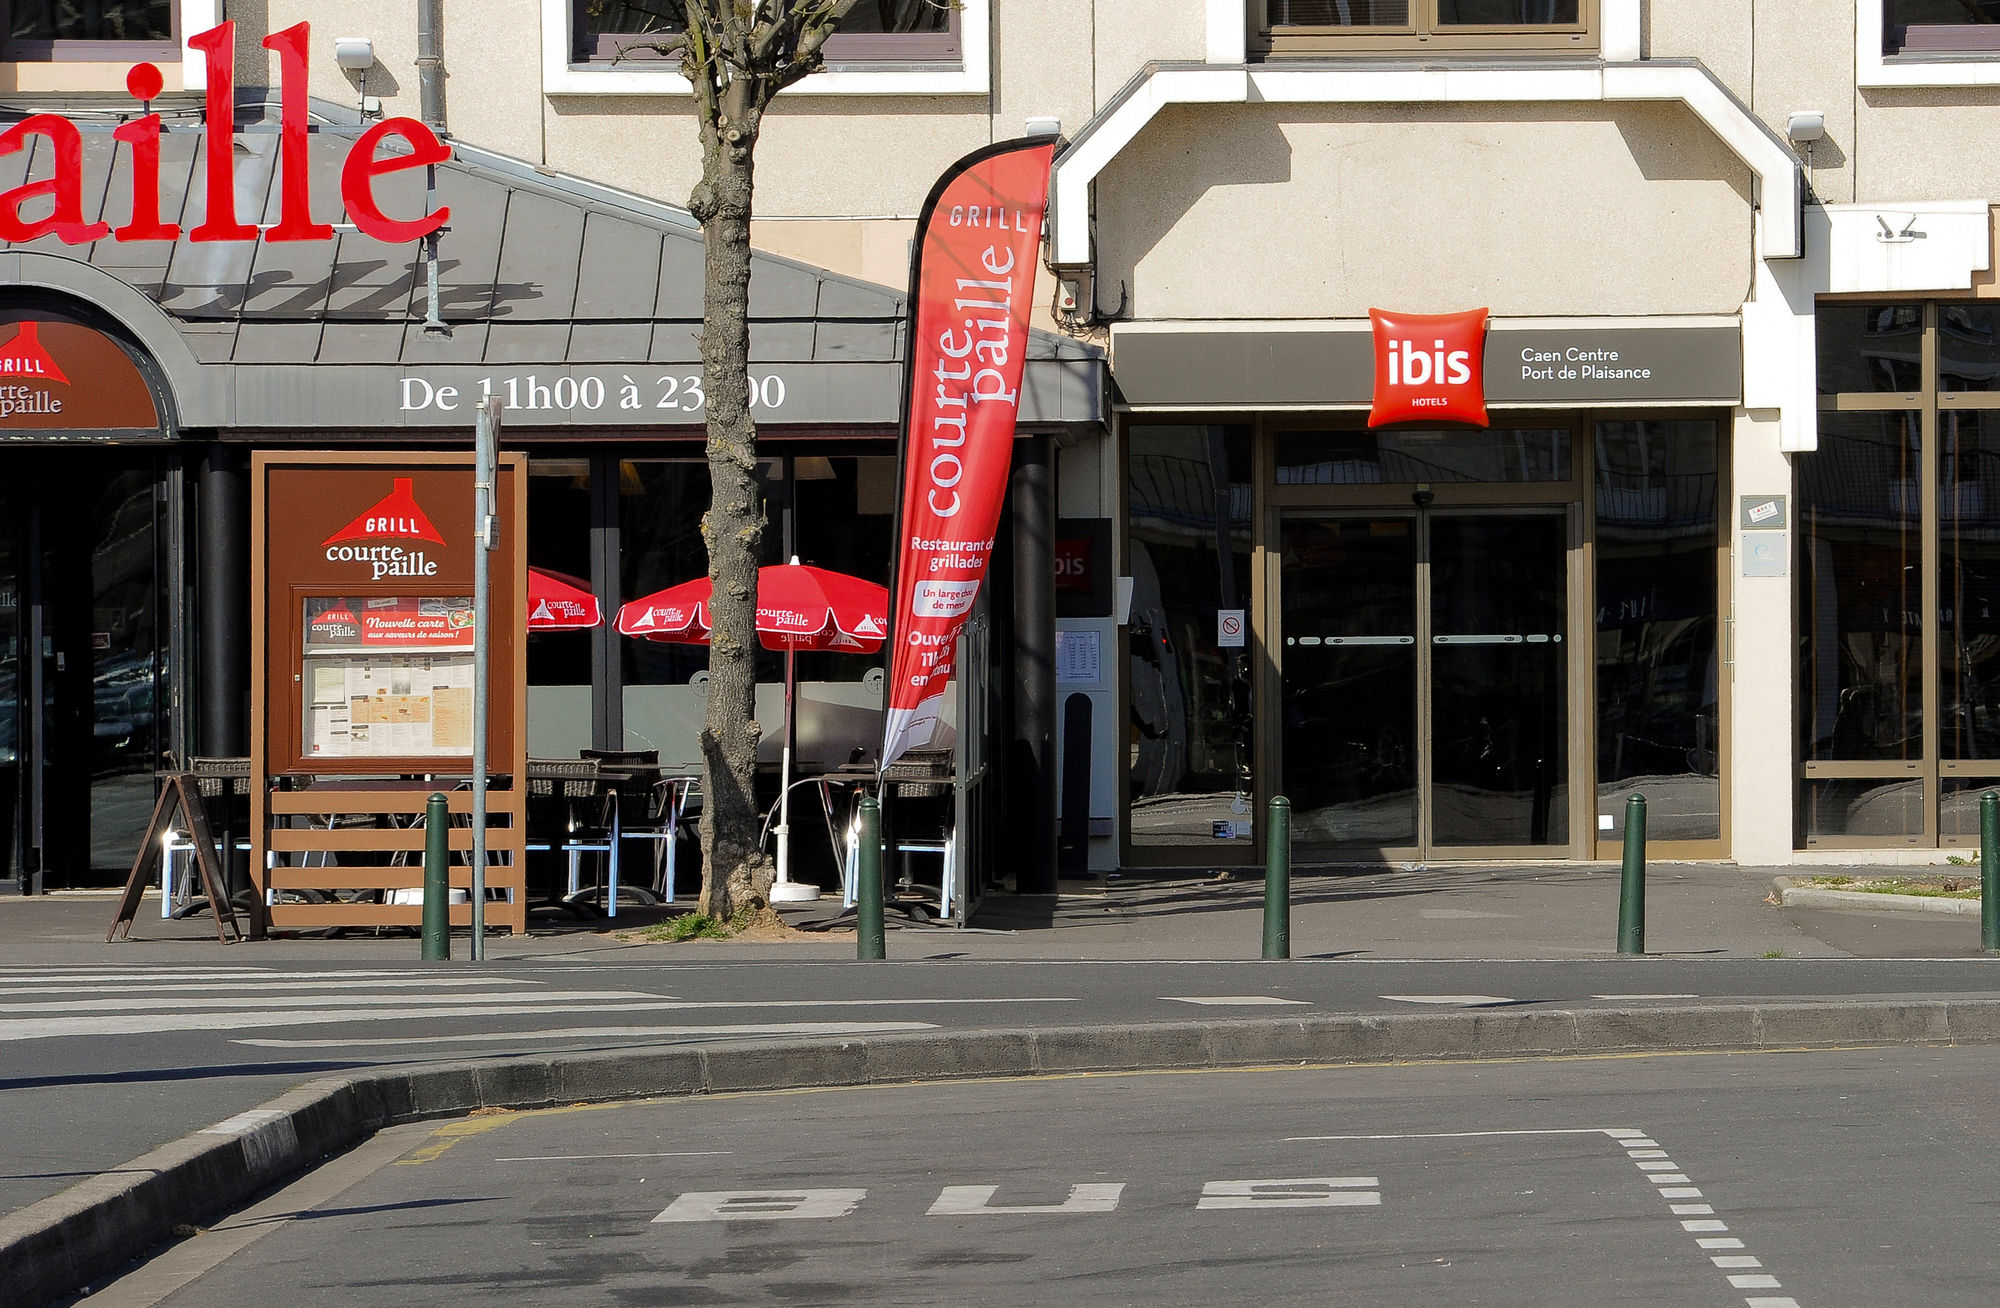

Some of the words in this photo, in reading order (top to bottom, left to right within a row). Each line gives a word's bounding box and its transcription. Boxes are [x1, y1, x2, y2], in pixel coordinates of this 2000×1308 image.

[949, 204, 1027, 233] GRILL
[954, 245, 1017, 407] paille
[1521, 348, 1561, 362] Caen
[1566, 348, 1619, 362] Centre
[0, 358, 45, 373] RILL
[1389, 340, 1471, 386] ibis
[1521, 366, 1554, 380] Port
[1559, 365, 1578, 379] de
[1582, 365, 1652, 380] Plaisance
[400, 378, 459, 411] De
[476, 375, 605, 411] 11h00
[620, 374, 643, 411] à
[656, 375, 785, 412] 230
[0, 391, 63, 417] paille
[1412, 397, 1448, 407] HOTELS
[928, 328, 974, 518] courte
[365, 517, 420, 533] GRILL
[911, 537, 985, 551] Restaurant
[326, 545, 403, 561] courte
[371, 552, 438, 580] paille
[930, 555, 983, 571] grillades
[922, 589, 936, 598] Un
[938, 589, 960, 600] large
[564, 604, 586, 618] paille
[932, 601, 944, 609] de
[327, 613, 349, 621] GRILL
[366, 617, 416, 628] Nouvelle
[417, 619, 445, 628] carte
[776, 614, 809, 626] paille
[330, 627, 356, 639] paille
[416, 630, 426, 638] de
[911, 675, 929, 686] en
[651, 1176, 1382, 1222] BUS
